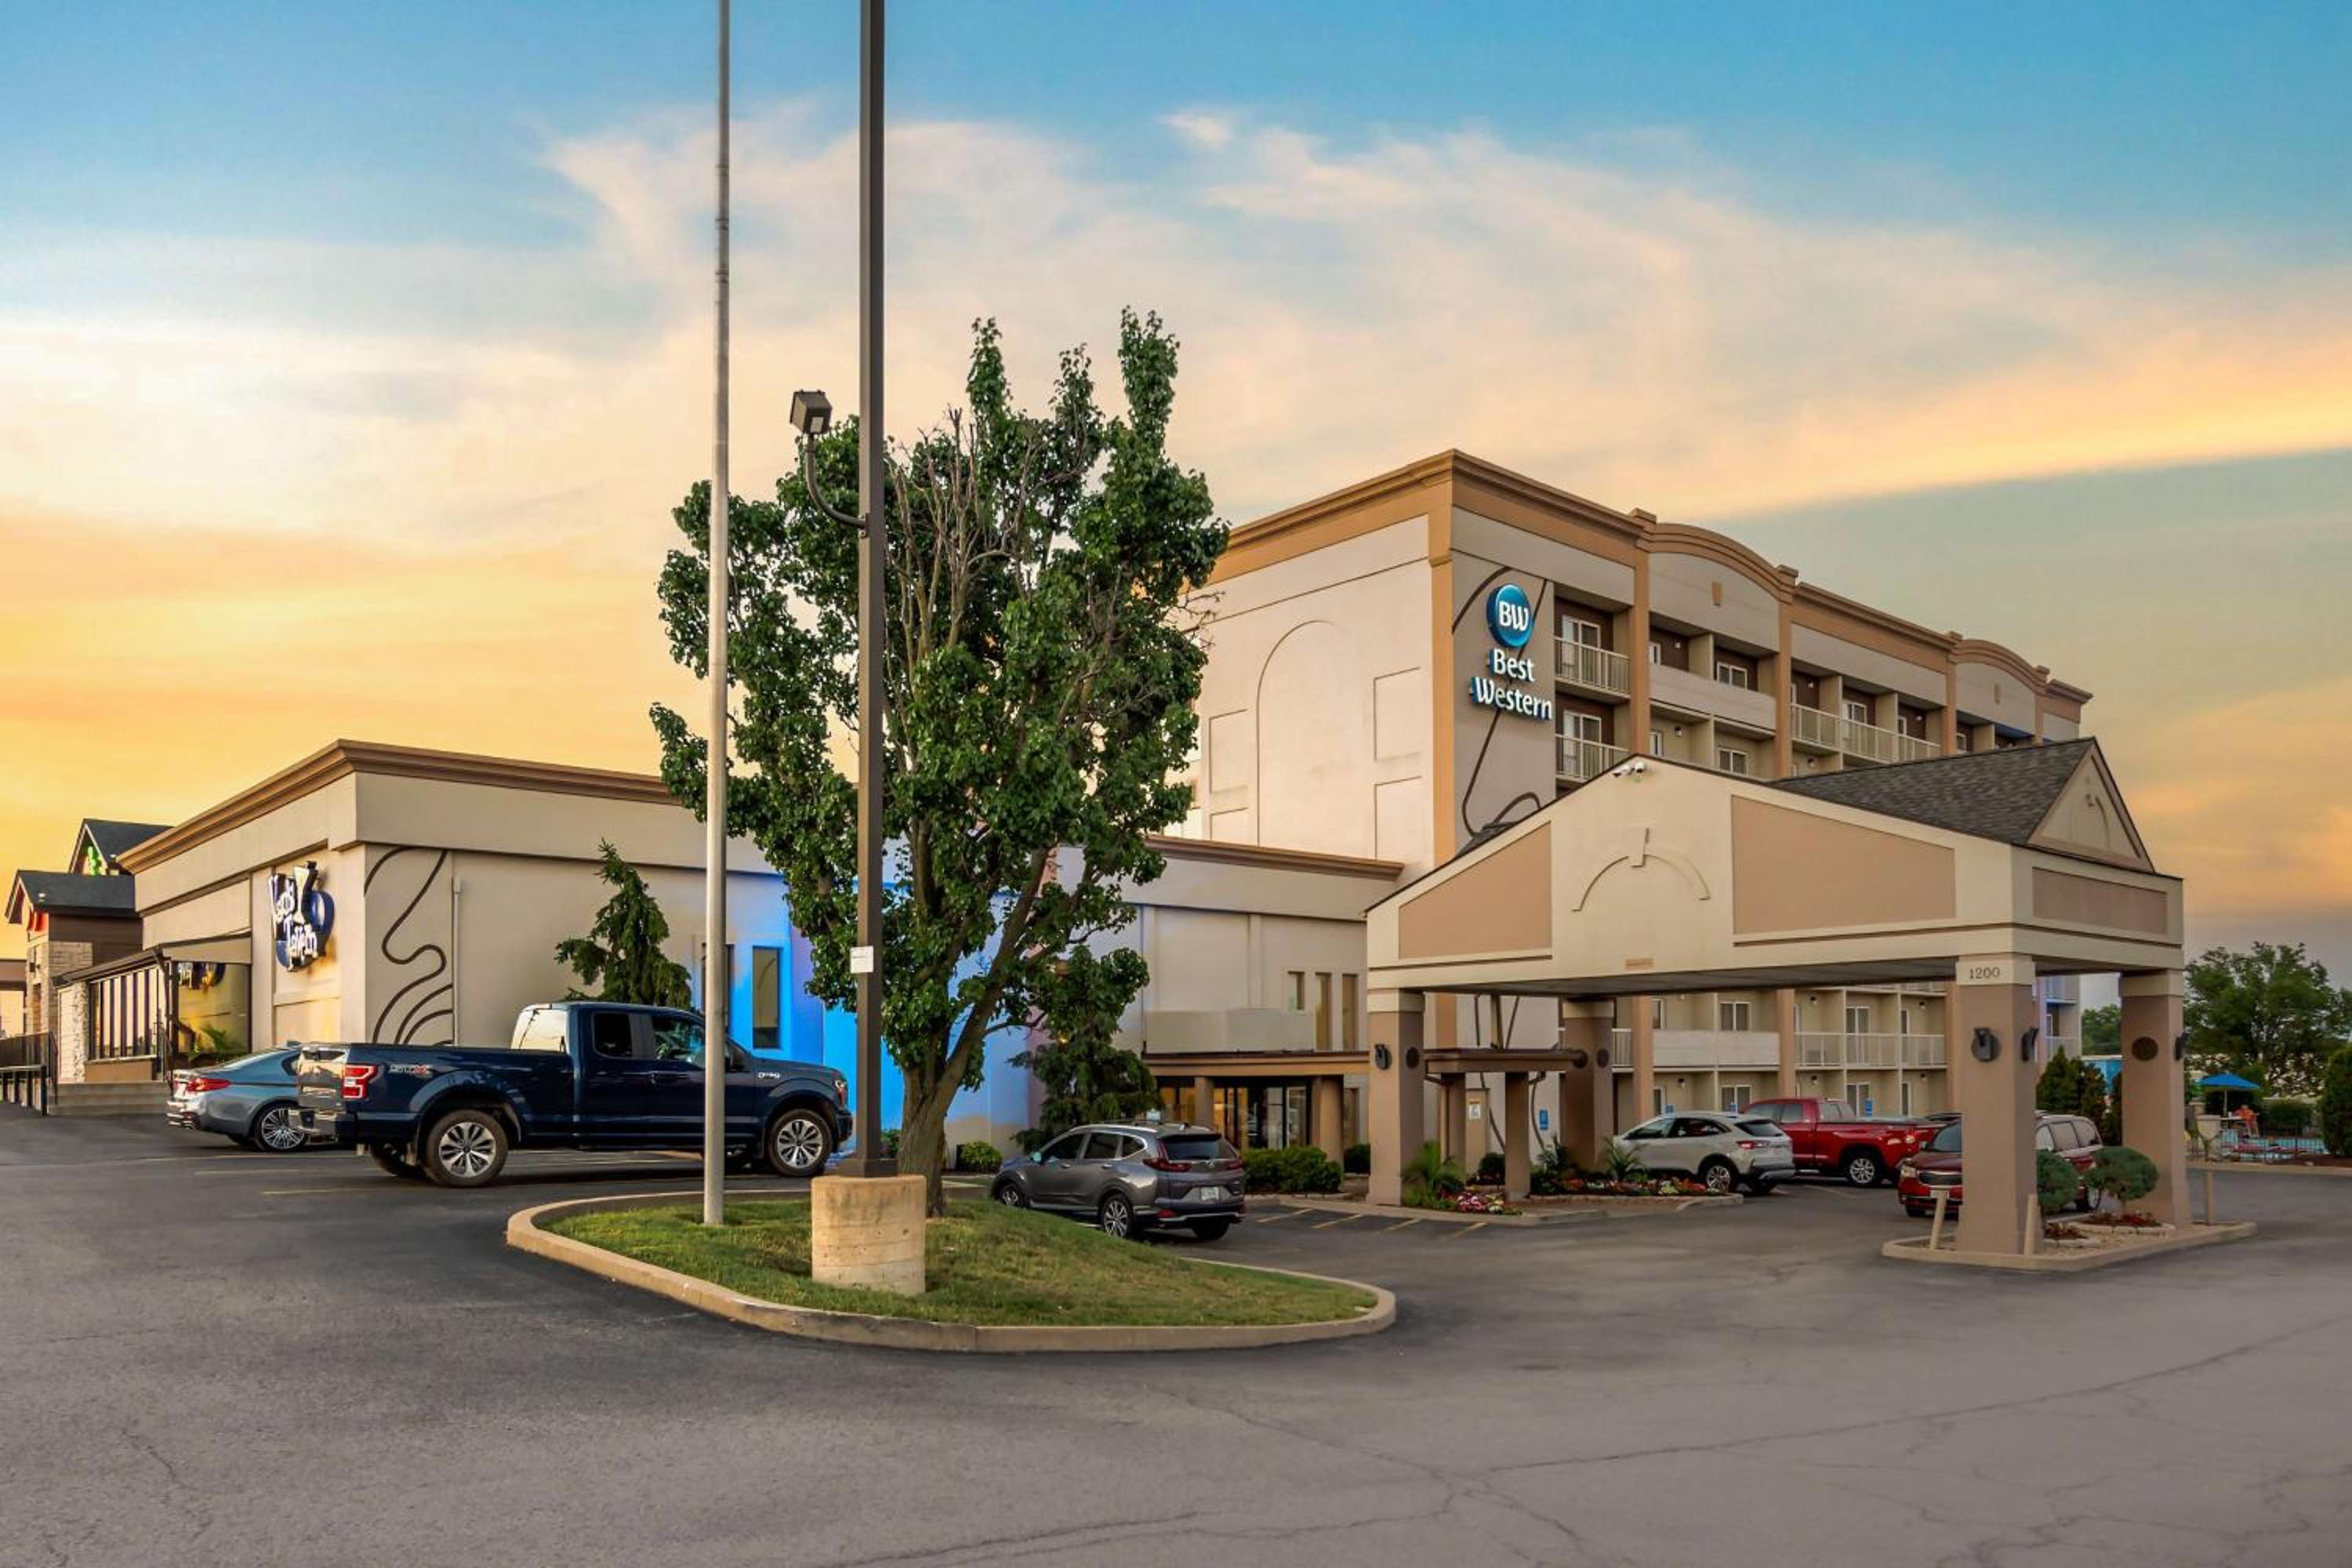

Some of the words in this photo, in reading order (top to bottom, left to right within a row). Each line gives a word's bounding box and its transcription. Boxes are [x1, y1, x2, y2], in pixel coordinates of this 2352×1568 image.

[1498, 601, 1530, 631] BW
[1492, 648, 1535, 683] Best
[1475, 676, 1553, 720] Western
[1969, 966, 2001, 980] 1200
